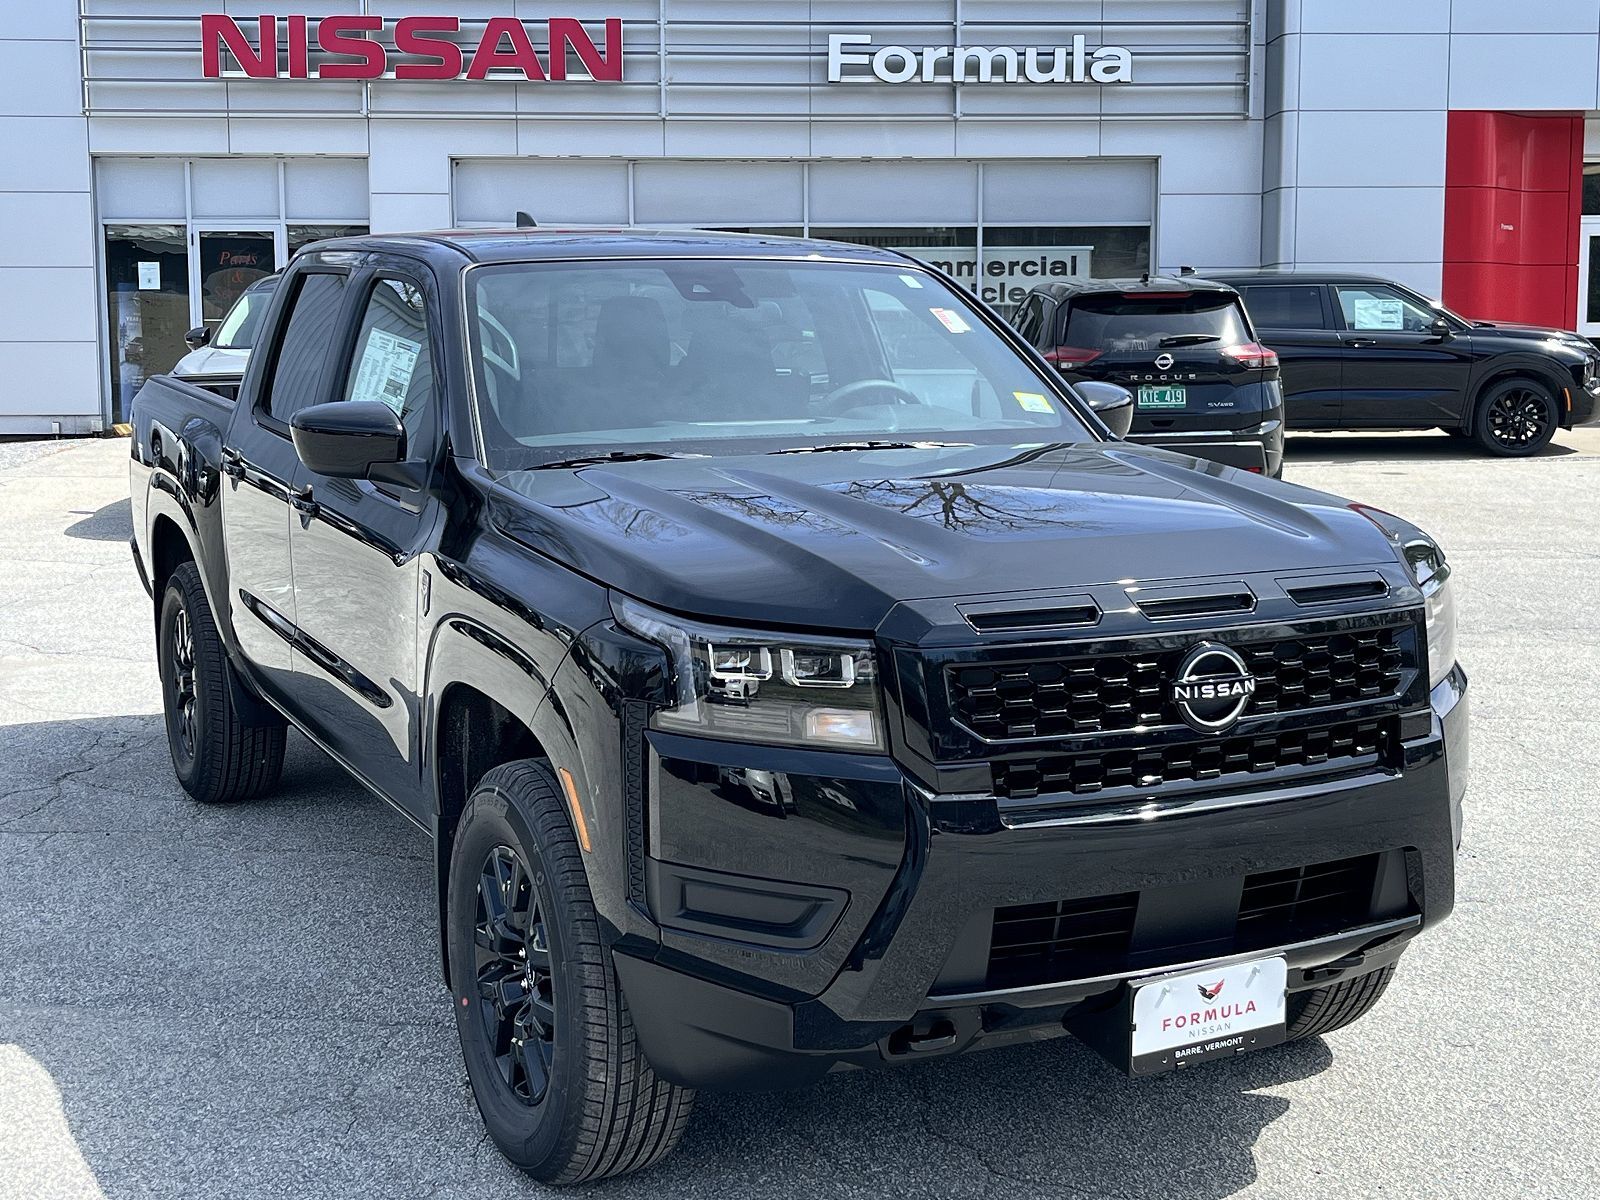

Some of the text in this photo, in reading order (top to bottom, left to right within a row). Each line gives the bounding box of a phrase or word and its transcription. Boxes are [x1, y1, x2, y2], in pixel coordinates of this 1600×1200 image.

[201, 14, 623, 82] NISSAN
[827, 33, 1134, 84] Formula
[1165, 390, 1182, 403] 419
[1174, 678, 1256, 699] NISSAN
[1162, 1000, 1257, 1032] FORMULA
[1188, 1021, 1232, 1038] NISSAN
[1175, 1036, 1244, 1059] BARRE, VERMONT
